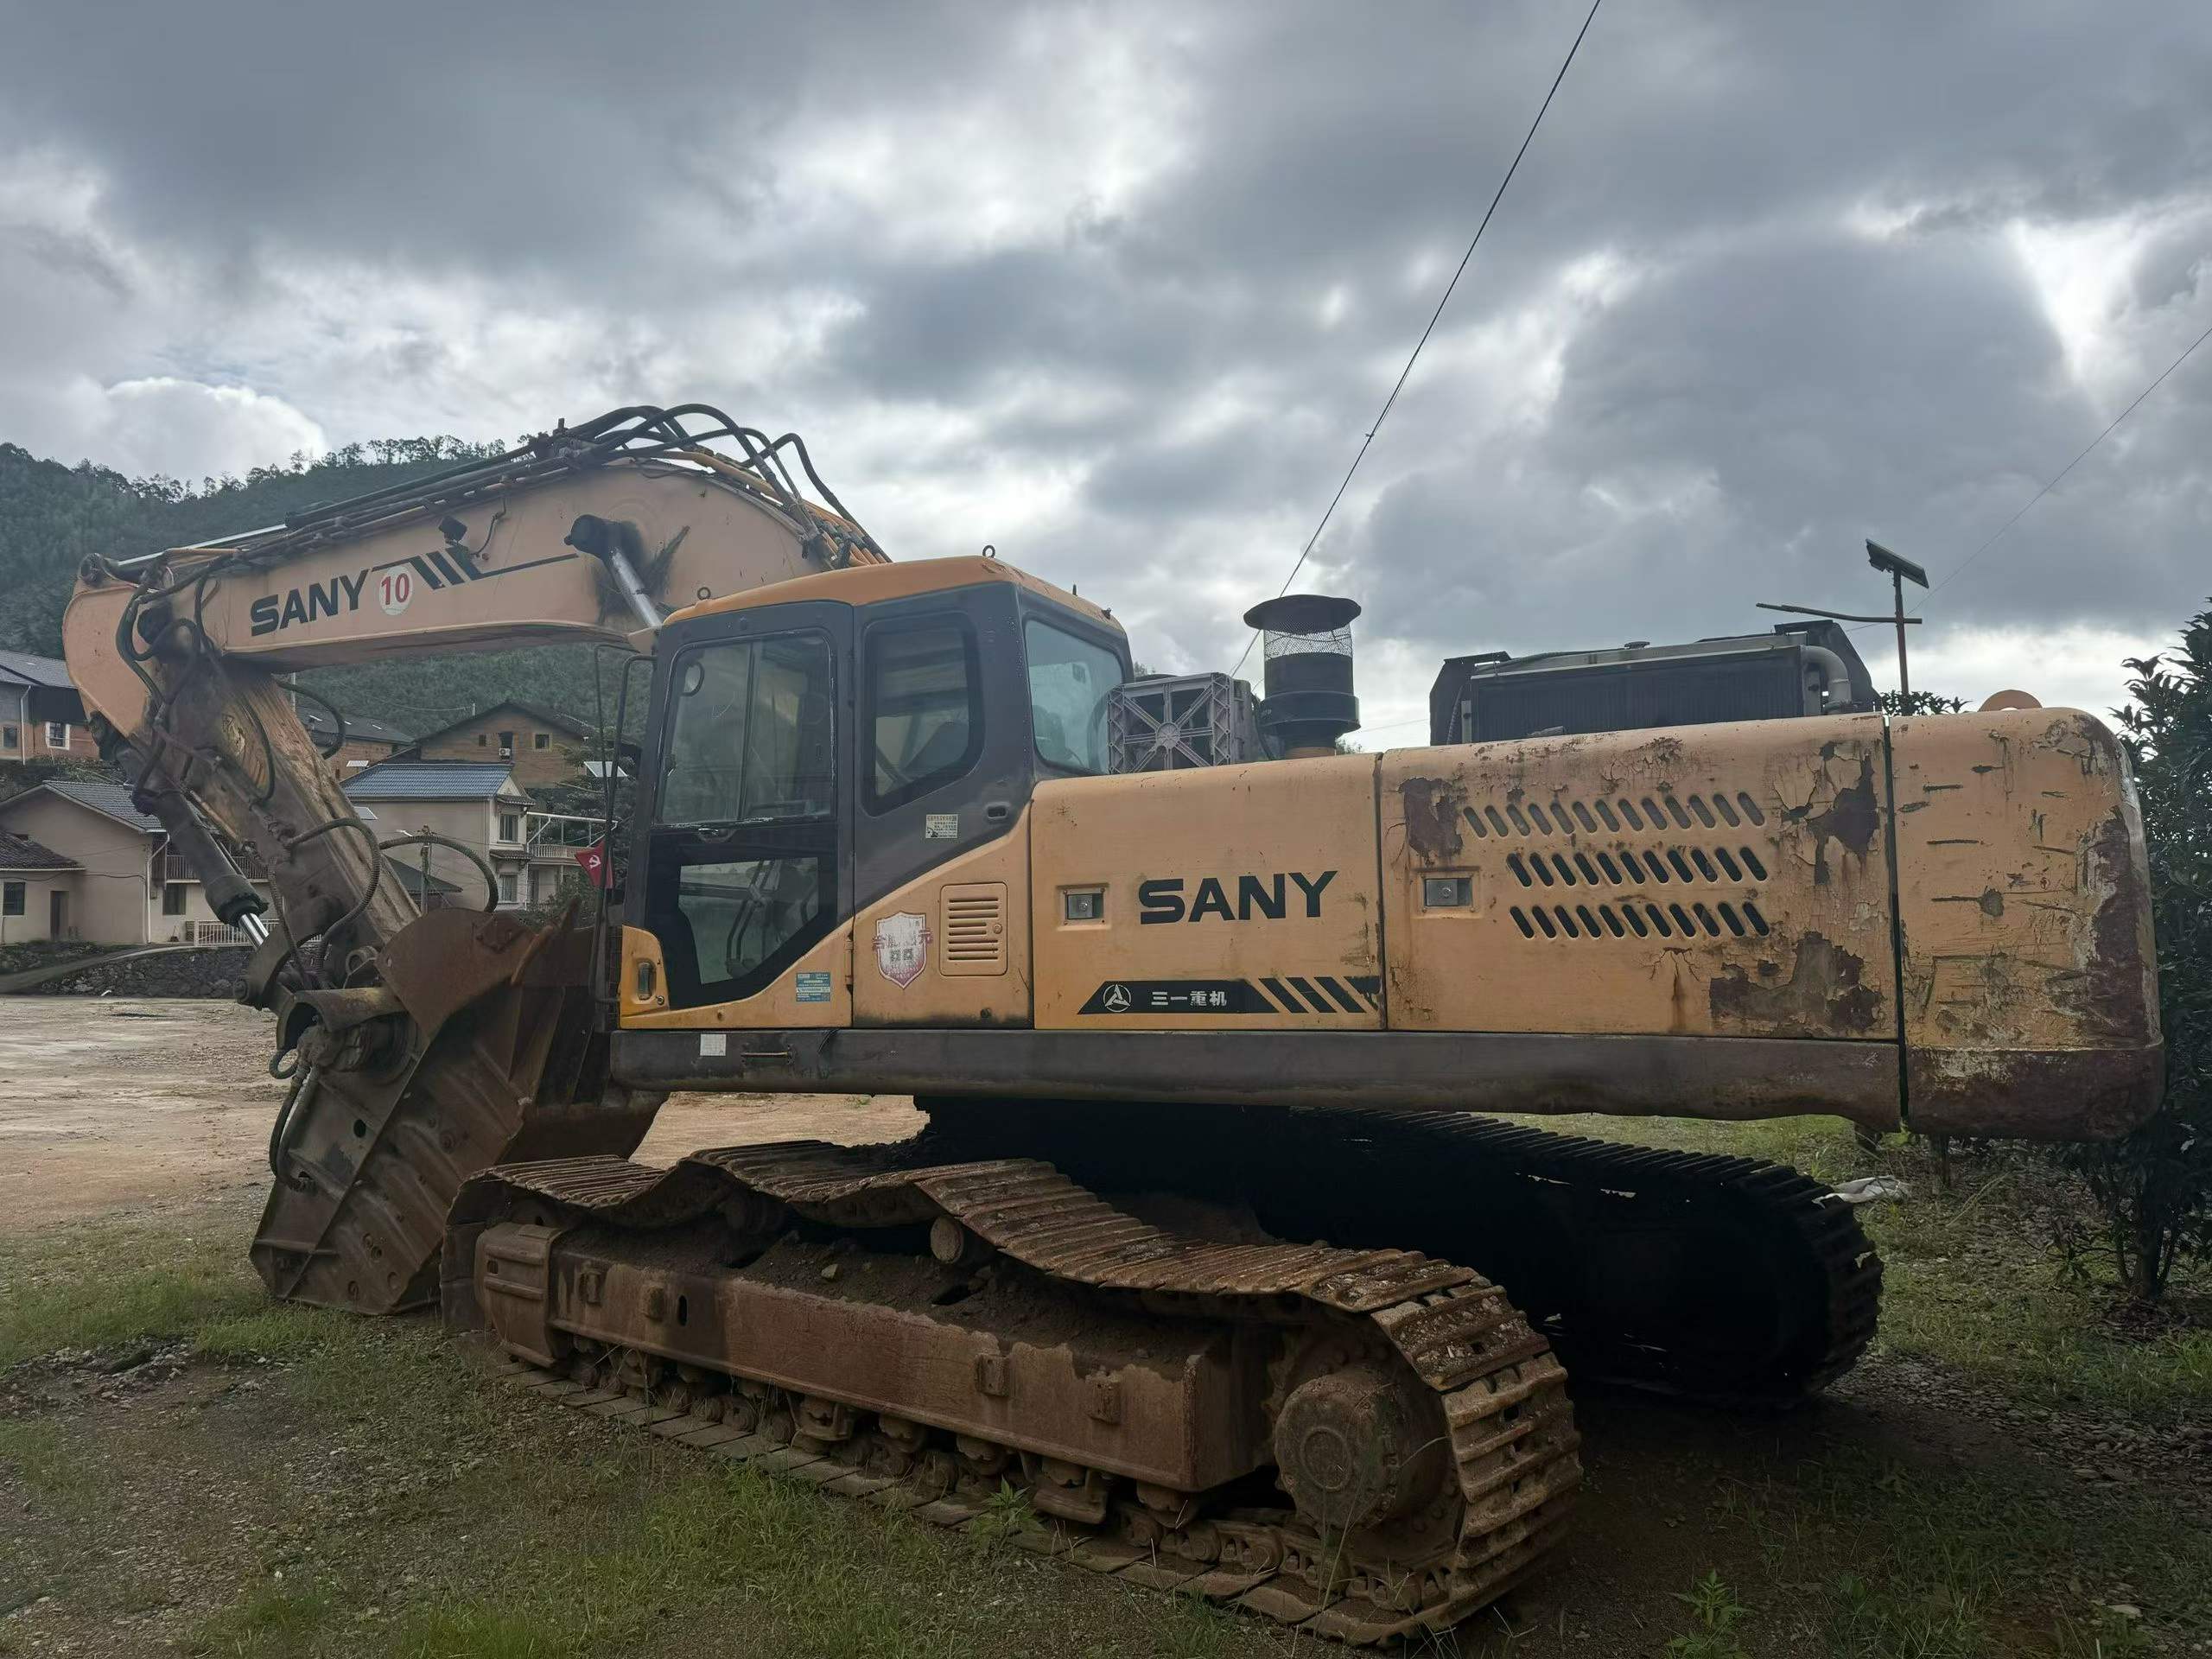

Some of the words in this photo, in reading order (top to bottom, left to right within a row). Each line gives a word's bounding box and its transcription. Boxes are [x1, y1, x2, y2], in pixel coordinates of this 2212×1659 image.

[251, 569, 370, 637] SANY
[381, 573, 410, 606] 10
[1139, 871, 1338, 925] SANY
[1151, 990, 1227, 1007] 三一重机
